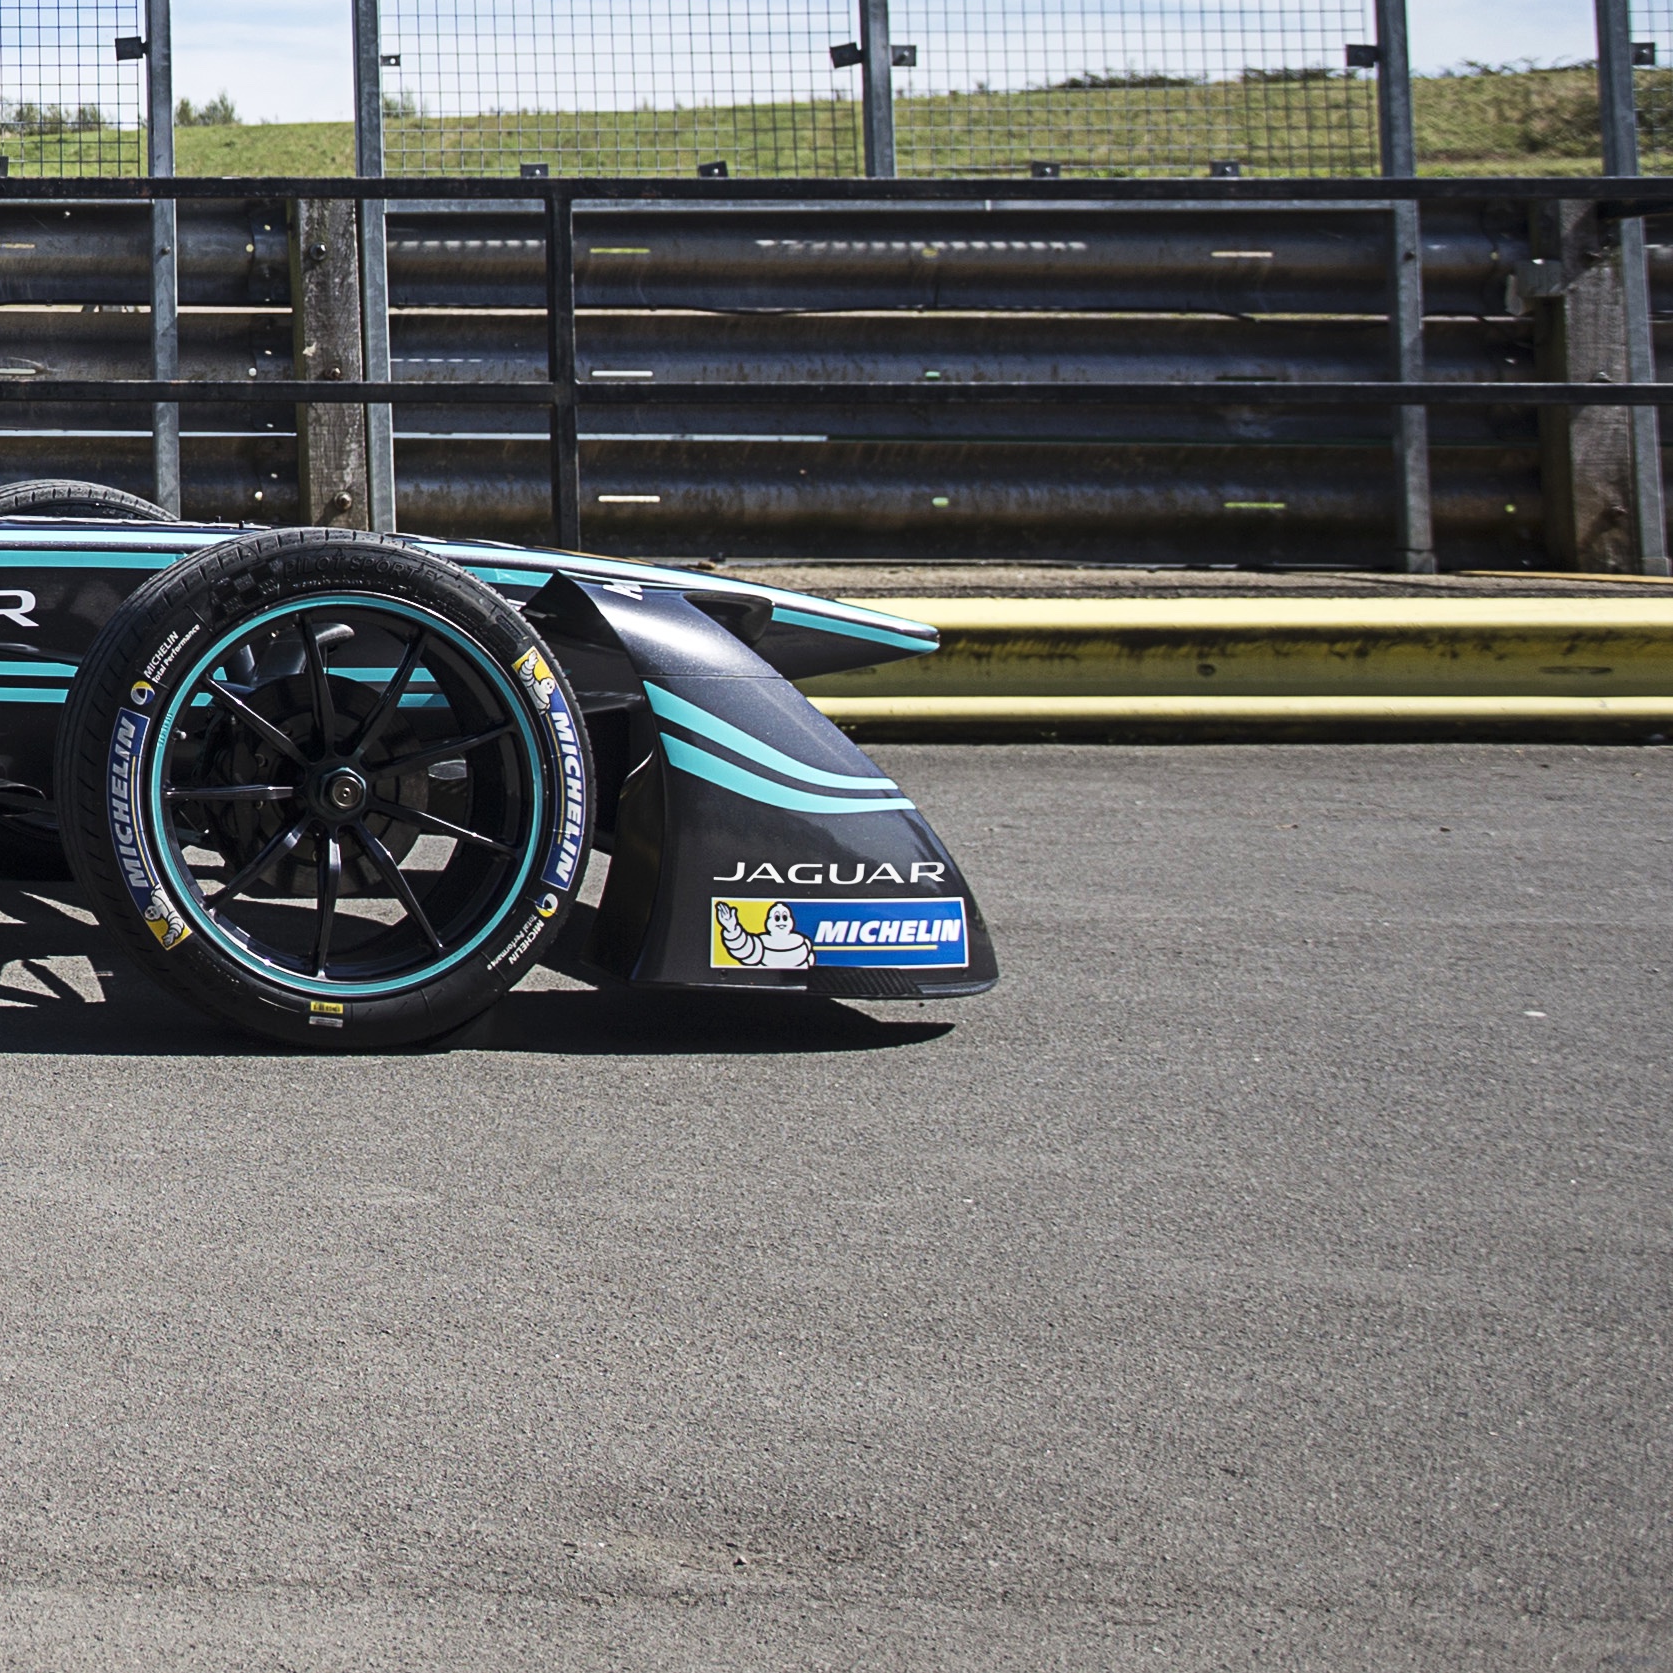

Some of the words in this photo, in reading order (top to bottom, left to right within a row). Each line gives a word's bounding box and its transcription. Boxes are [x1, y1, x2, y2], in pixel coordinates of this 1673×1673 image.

[143, 630, 179, 679] MICHELIN
[151, 663, 167, 684] Total
[163, 623, 201, 667] Performance
[111, 715, 150, 889] MICHELIN
[551, 711, 583, 884] MICHELIN
[713, 861, 946, 885] JAGUAR
[507, 918, 545, 965] MICHELIN
[814, 919, 961, 943] MICHELIN
